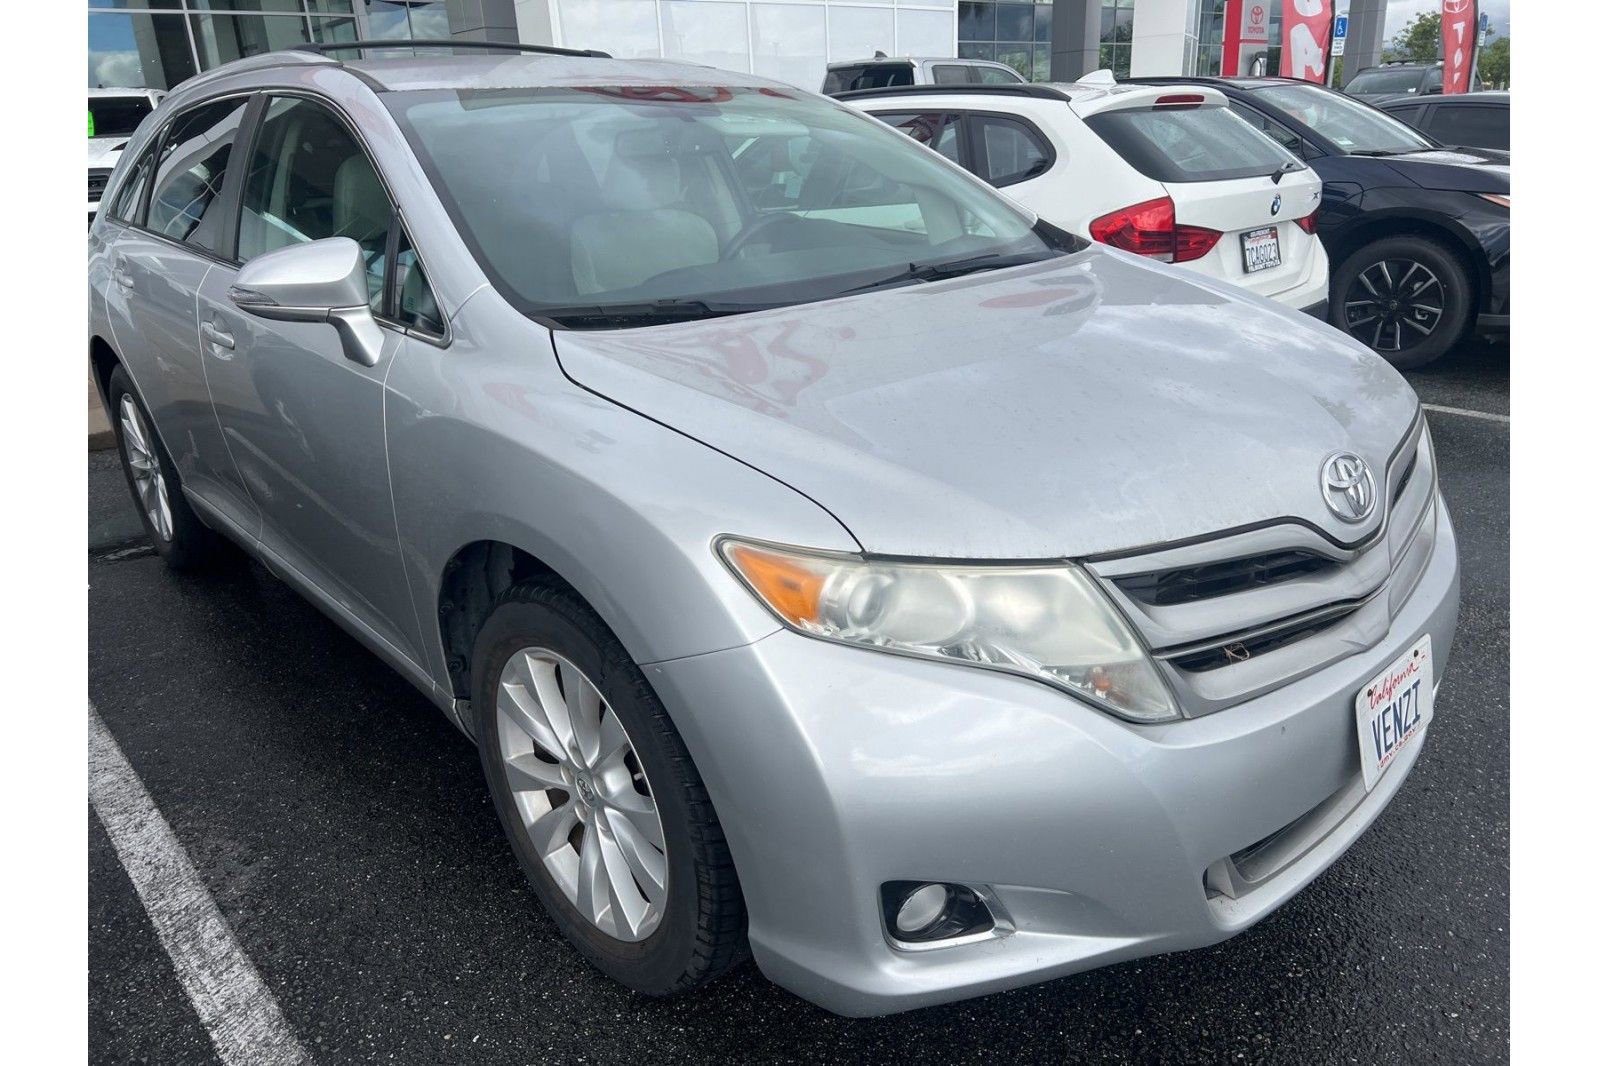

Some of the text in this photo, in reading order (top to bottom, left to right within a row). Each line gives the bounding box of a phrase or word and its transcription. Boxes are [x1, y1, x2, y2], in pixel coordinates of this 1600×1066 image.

[1247, 26, 1265, 34] TOYOTA
[1368, 661, 1419, 710] California
[1371, 678, 1421, 761] VENZI
